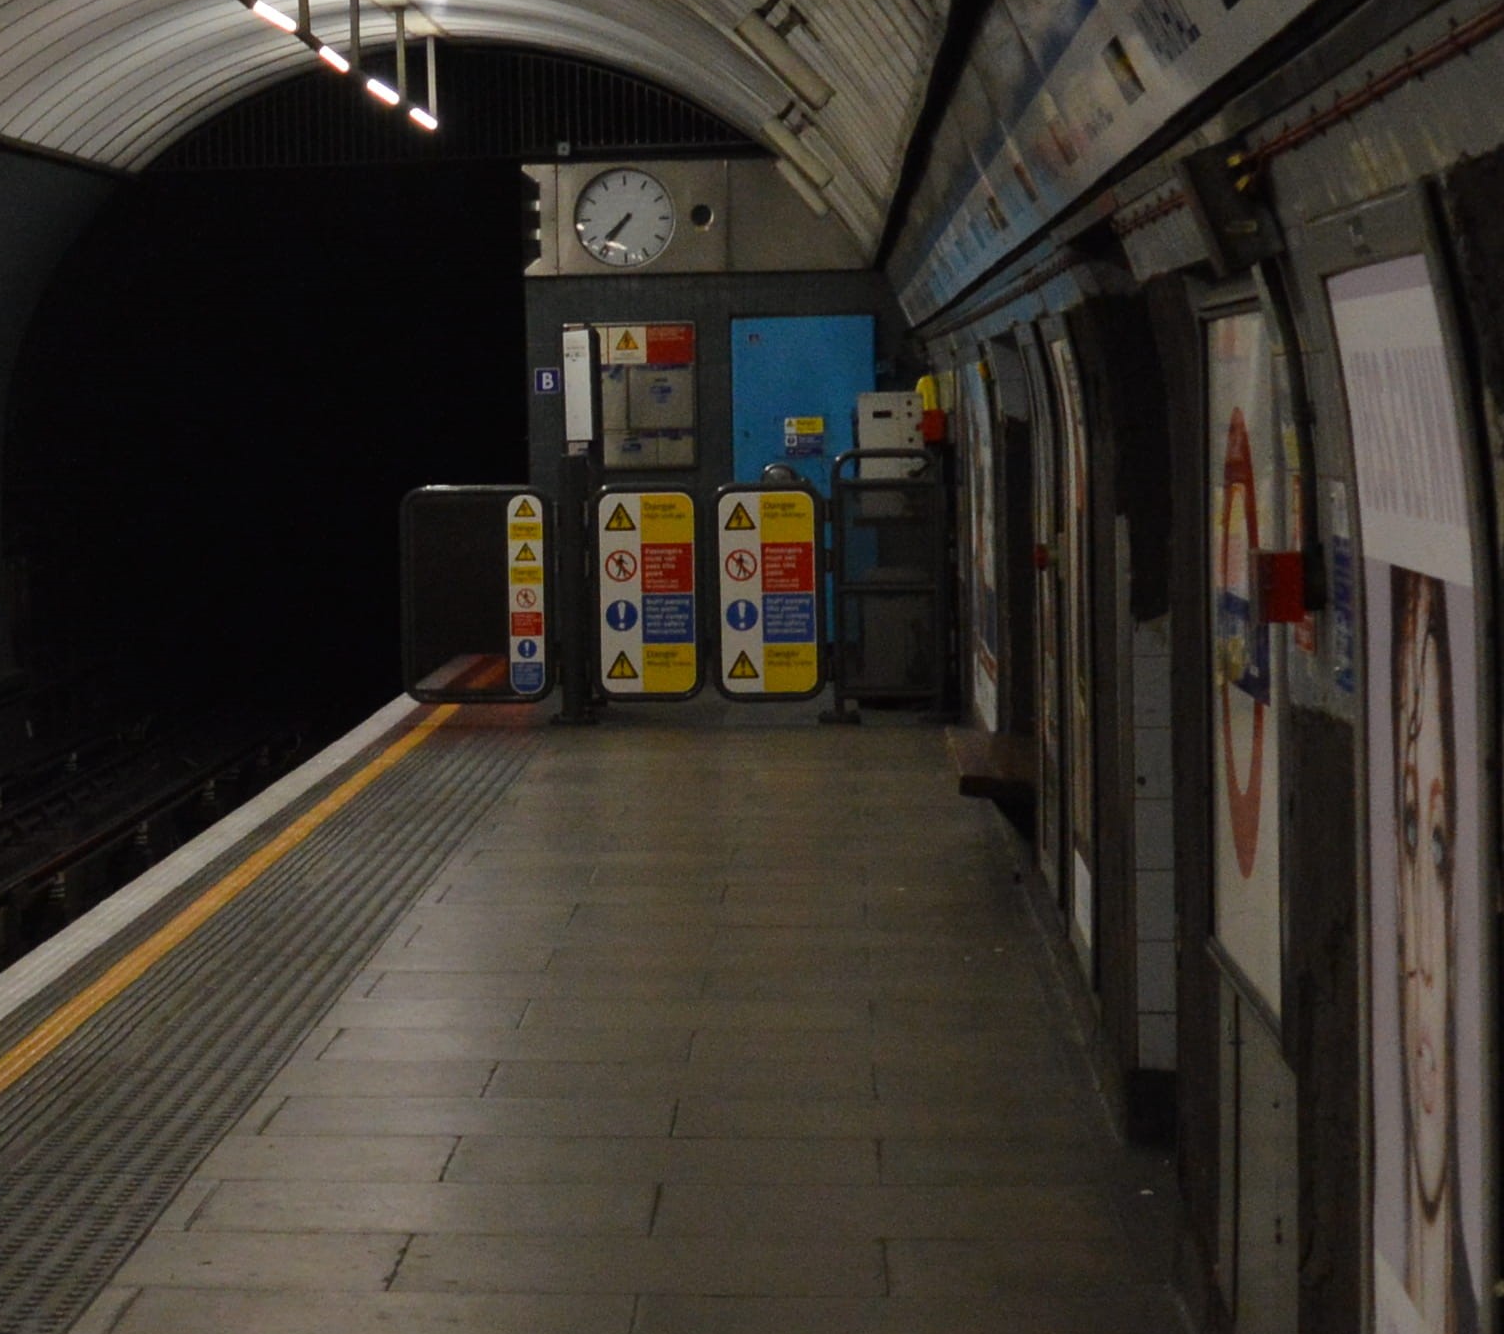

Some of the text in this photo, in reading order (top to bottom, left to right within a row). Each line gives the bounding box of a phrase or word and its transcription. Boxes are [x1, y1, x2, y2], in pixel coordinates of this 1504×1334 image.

[541, 370, 555, 390] B
[643, 502, 676, 511] Danger
[763, 501, 796, 511] Danger
[644, 547, 683, 556] Passengers
[764, 547, 803, 556] Passengers
[647, 650, 679, 658] Danger
[767, 649, 800, 658] Danger
